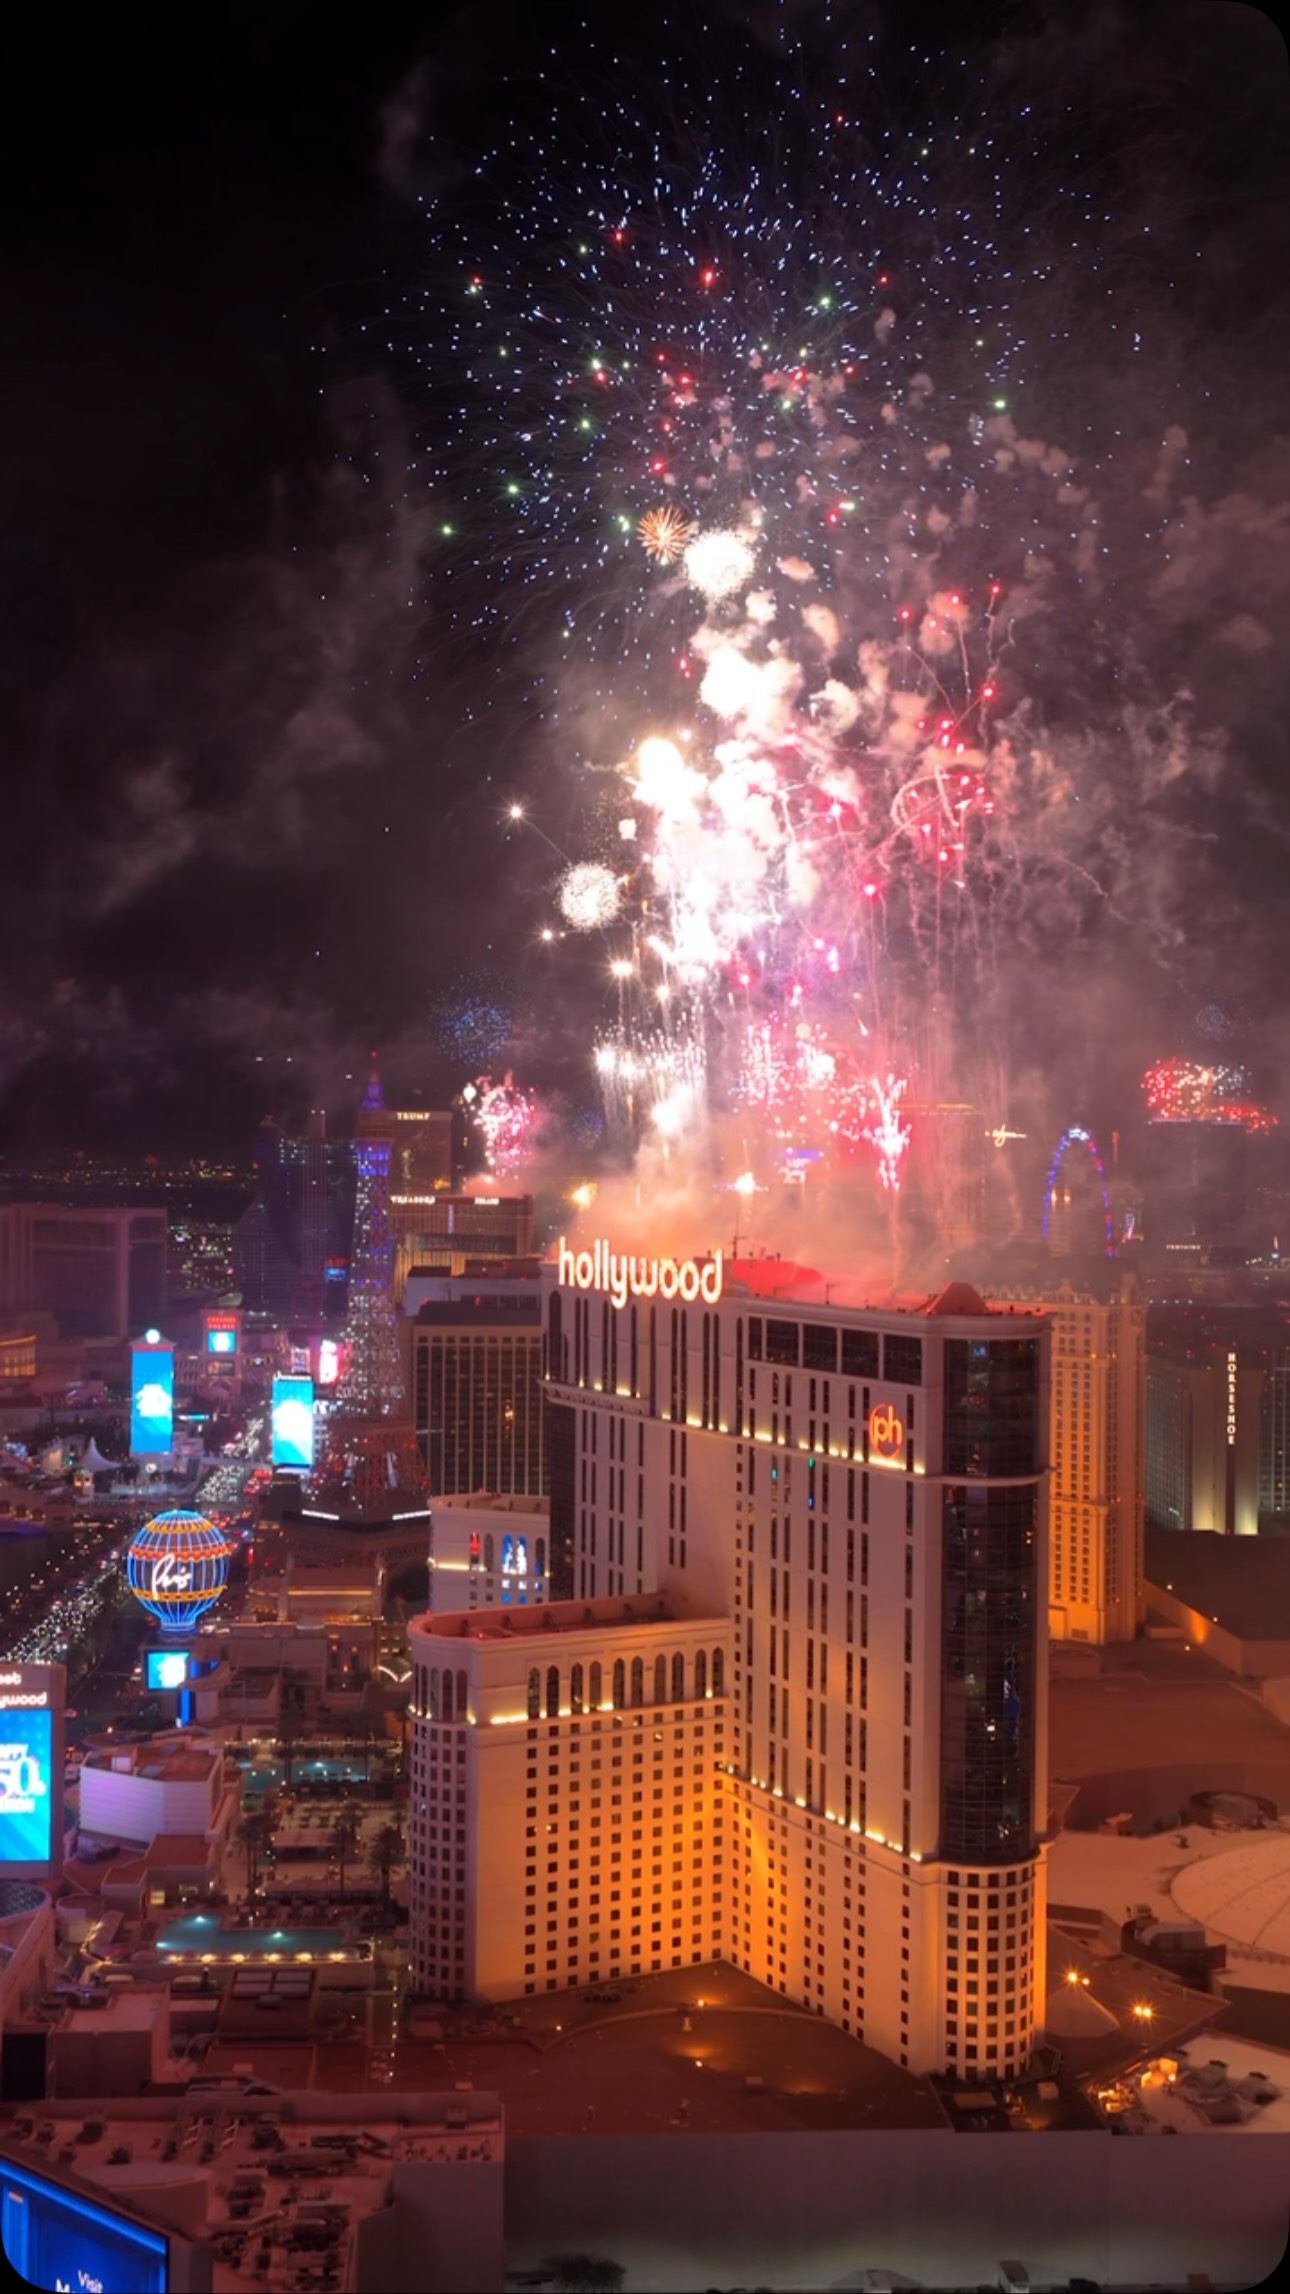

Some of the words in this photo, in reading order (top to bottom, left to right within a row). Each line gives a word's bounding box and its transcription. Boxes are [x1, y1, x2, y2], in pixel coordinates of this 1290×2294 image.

[396, 1111, 431, 1121] TRUMP
[558, 1235, 723, 1309] hollywood
[1226, 1351, 1238, 1446] HORSESHOE
[77, 2269, 104, 2293] Visit
